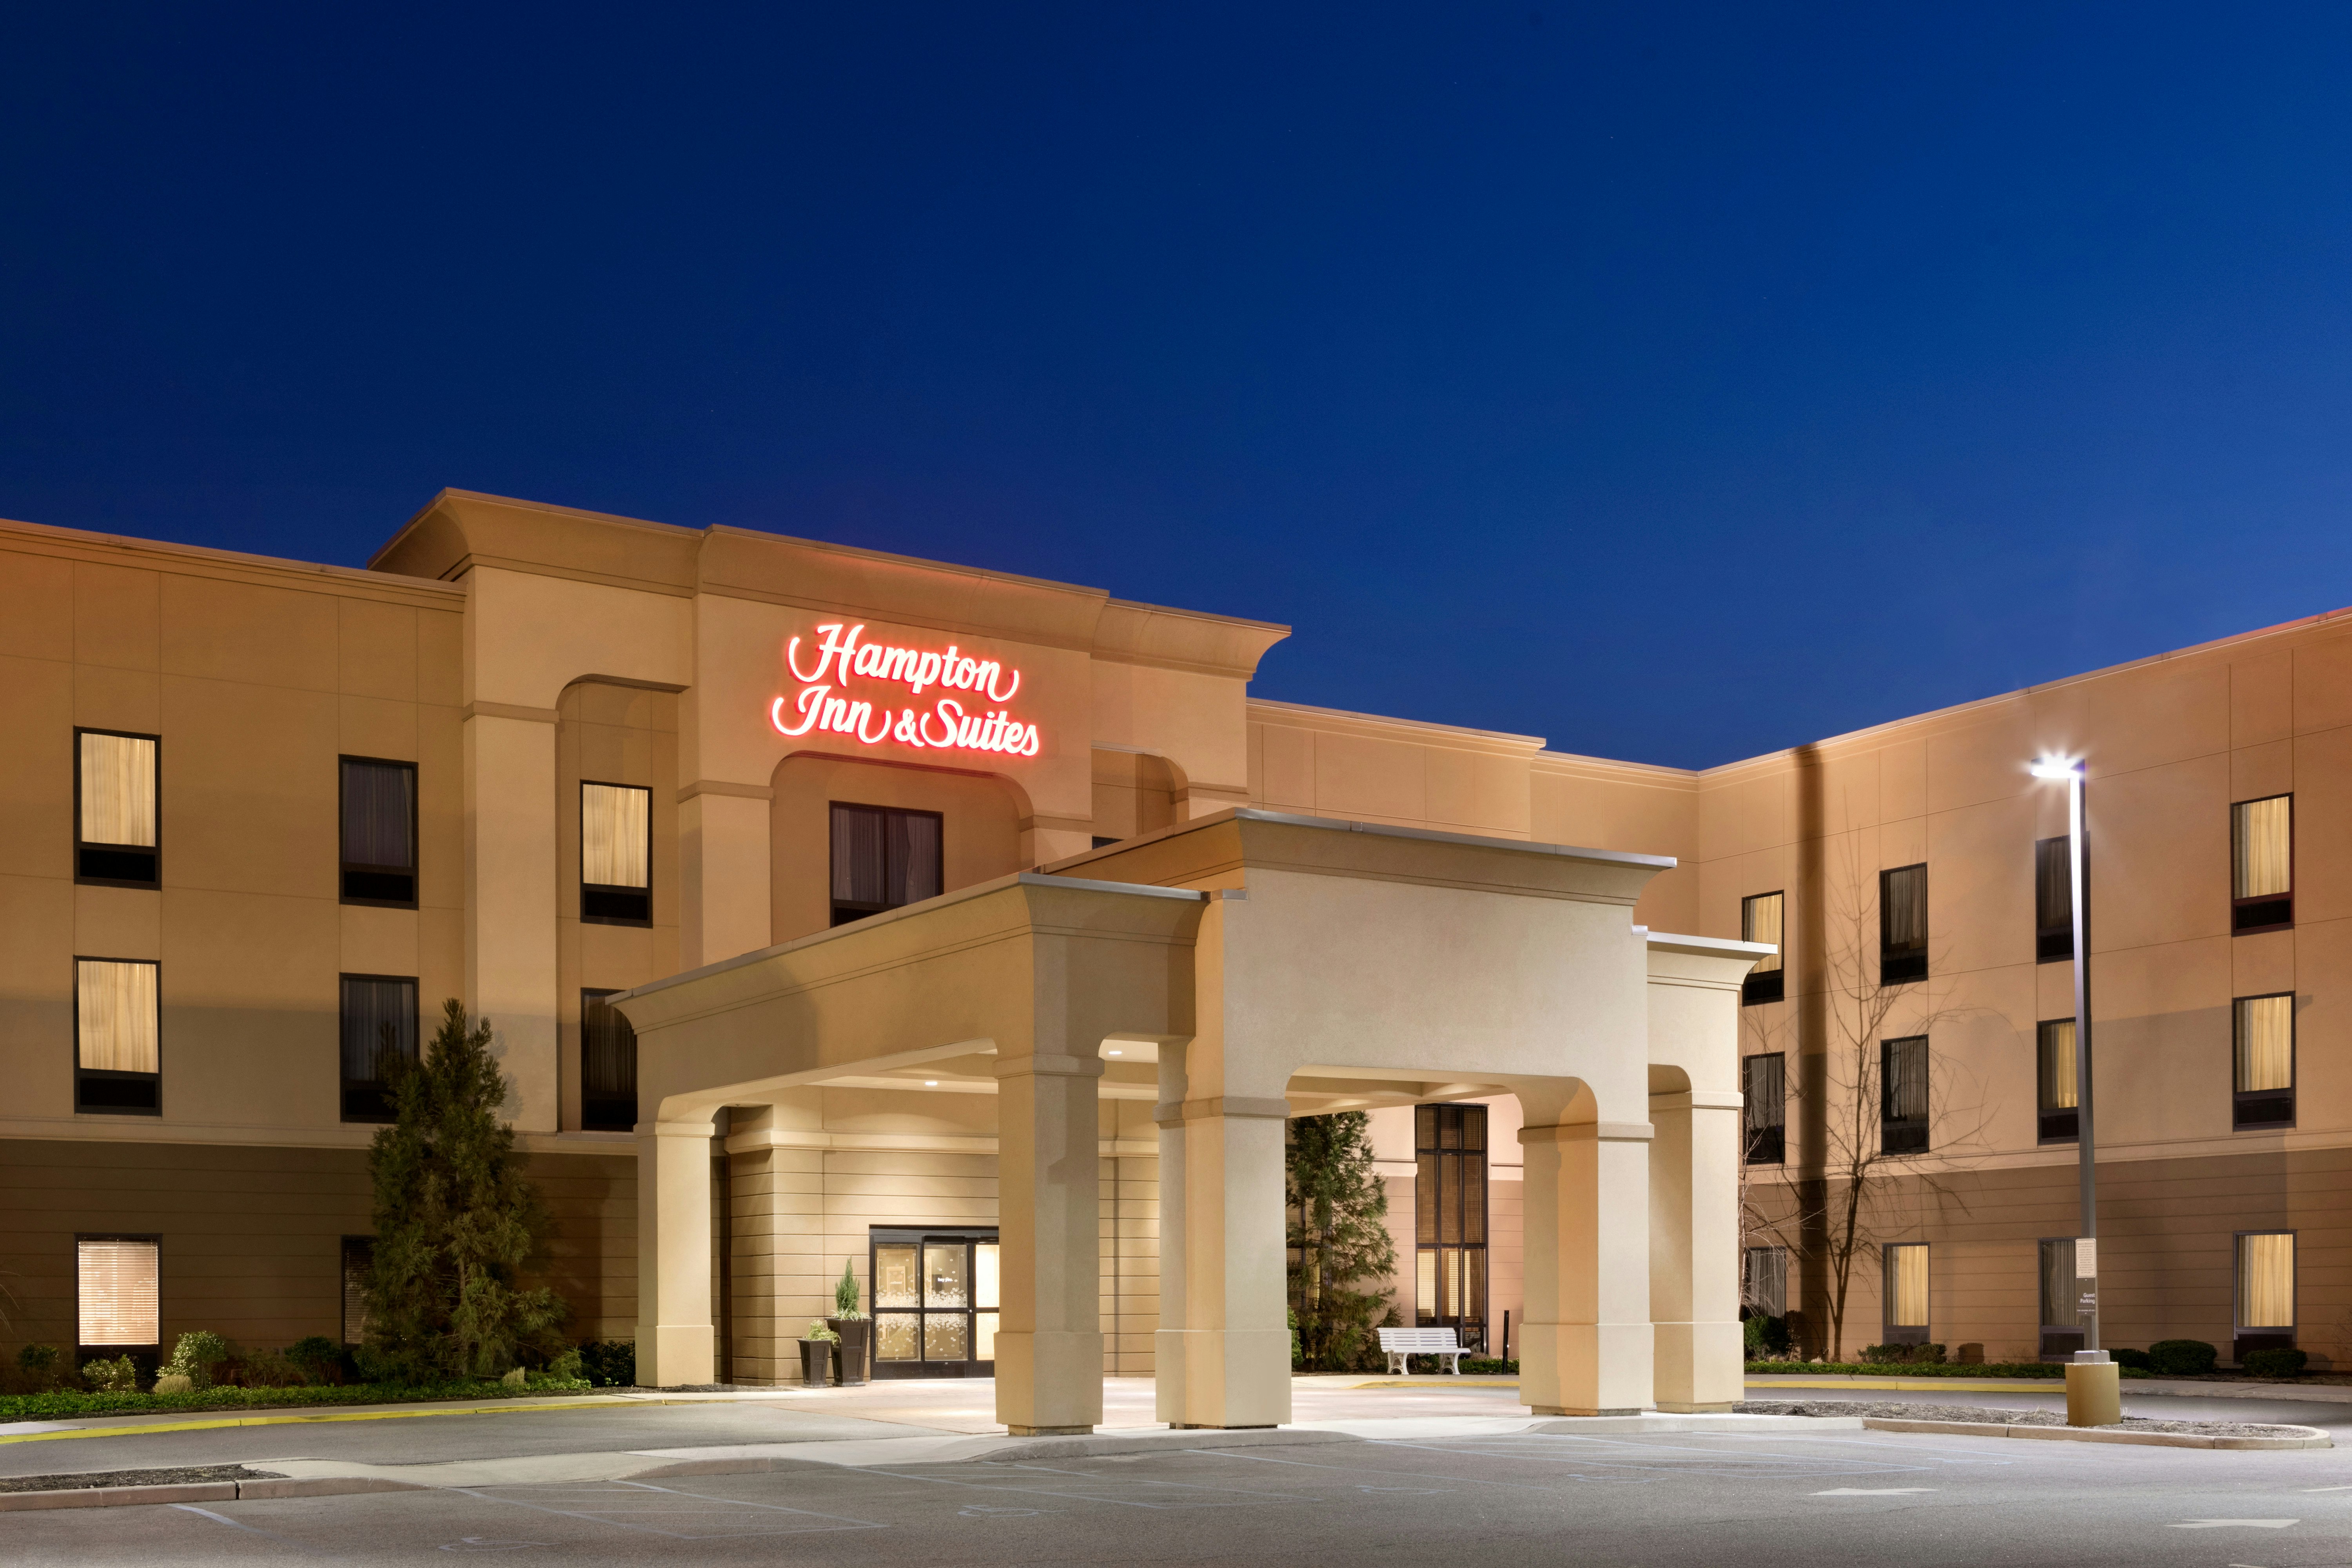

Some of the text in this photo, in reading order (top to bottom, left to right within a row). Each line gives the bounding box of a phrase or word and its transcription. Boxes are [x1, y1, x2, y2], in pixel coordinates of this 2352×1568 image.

[789, 624, 1019, 702] Hampton
[772, 685, 891, 744] Inn
[920, 699, 1039, 756] Suites
